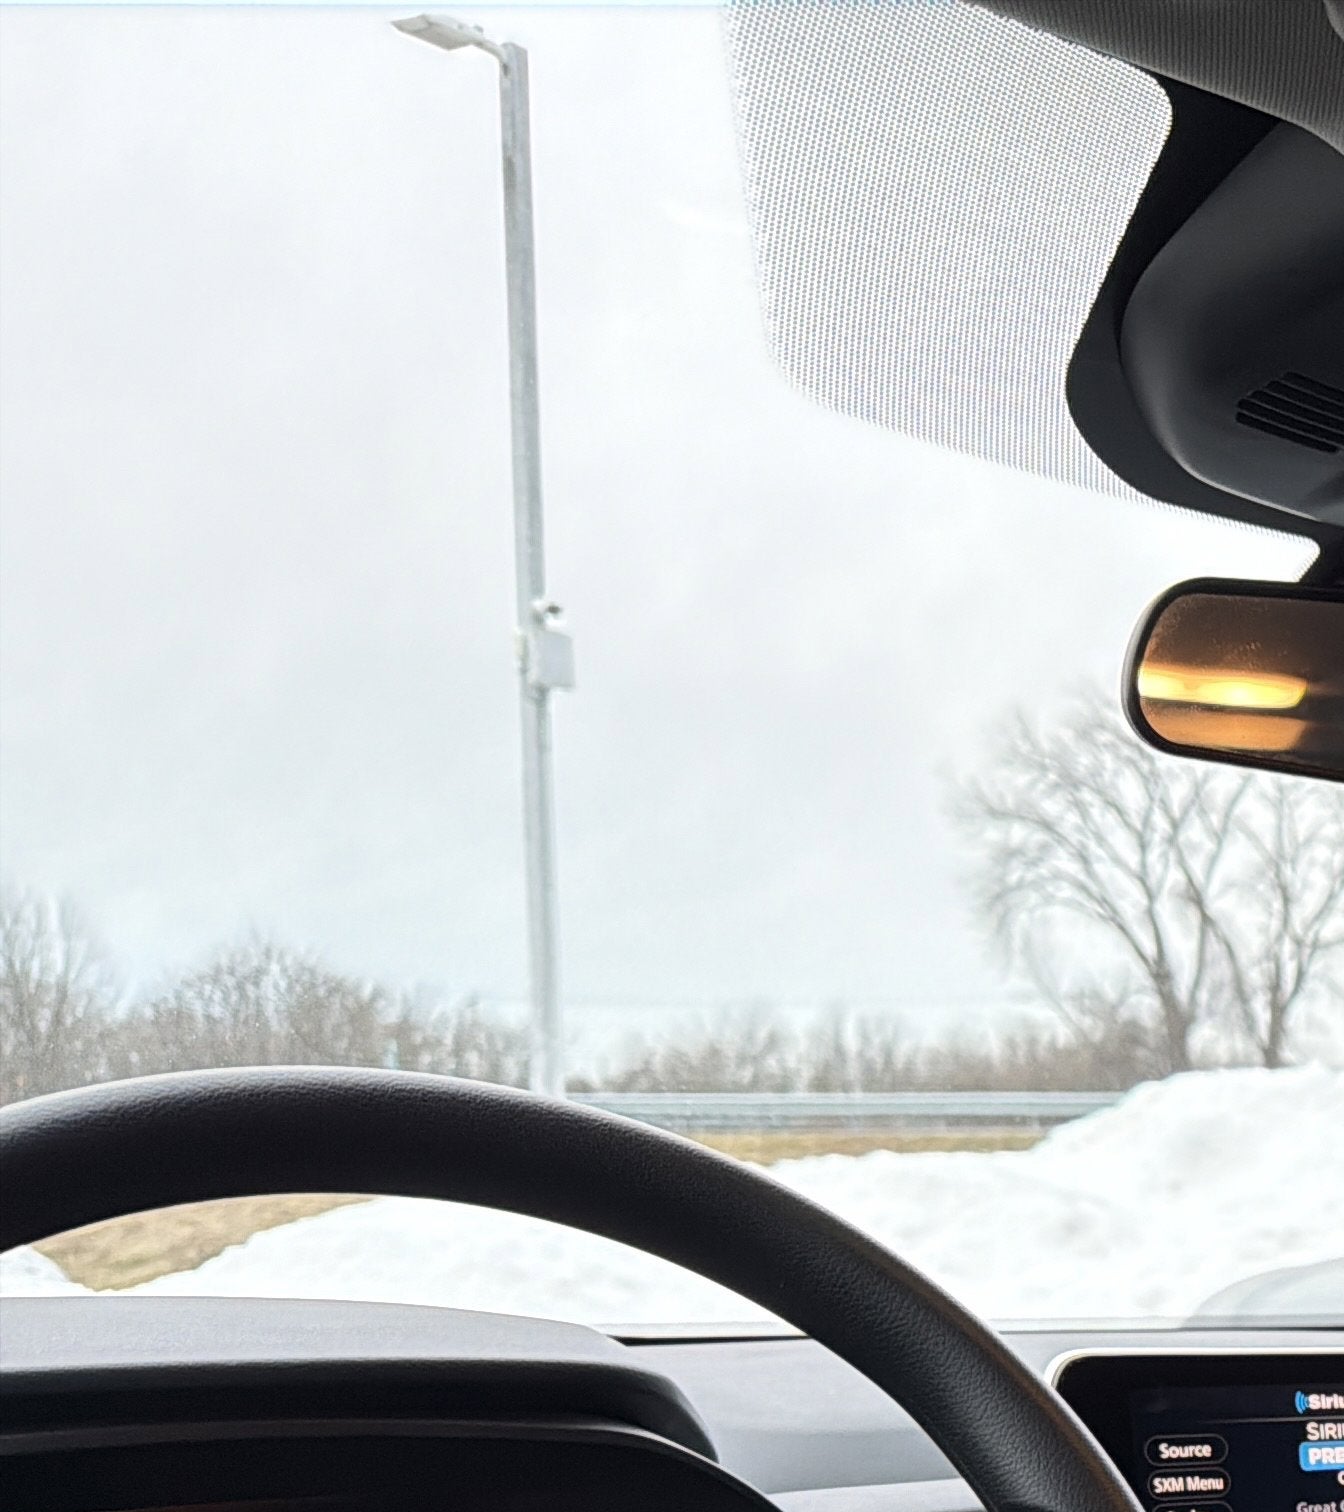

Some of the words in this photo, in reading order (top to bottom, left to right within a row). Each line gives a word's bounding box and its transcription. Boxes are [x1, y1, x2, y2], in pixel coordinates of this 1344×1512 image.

[1158, 1442, 1212, 1459] Source
[1153, 1477, 1185, 1494] SXM
[1186, 1476, 1224, 1492] Menu
